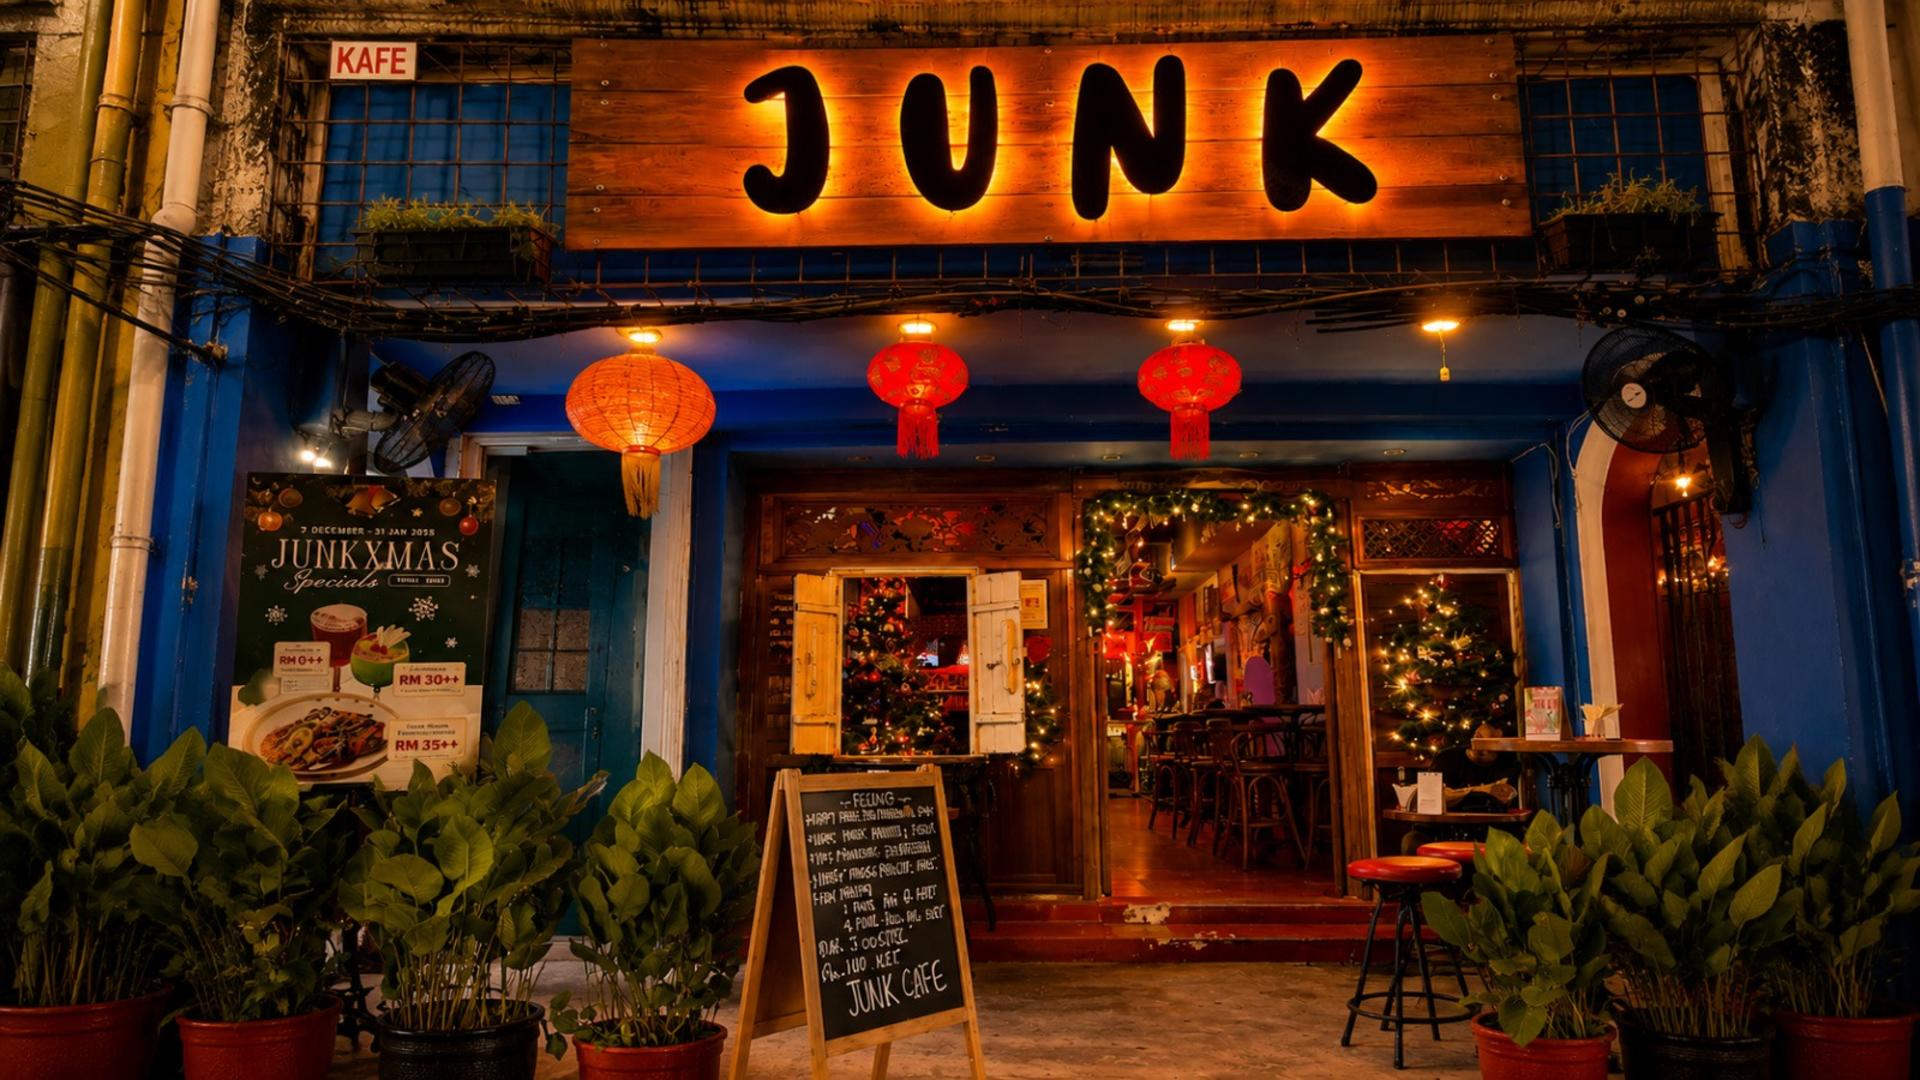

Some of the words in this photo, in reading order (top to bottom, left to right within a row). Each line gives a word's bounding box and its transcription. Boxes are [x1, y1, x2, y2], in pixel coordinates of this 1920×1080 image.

[336, 46, 407, 75] KAFE
[743, 54, 1378, 220] JUNK
[283, 568, 379, 594] Specials
[399, 675, 423, 686] RM
[425, 675, 460, 686] 30++
[395, 740, 419, 752] RM
[422, 738, 459, 752] 35++
[845, 972, 901, 1017] JUNK
[901, 958, 948, 1000] CAFE
